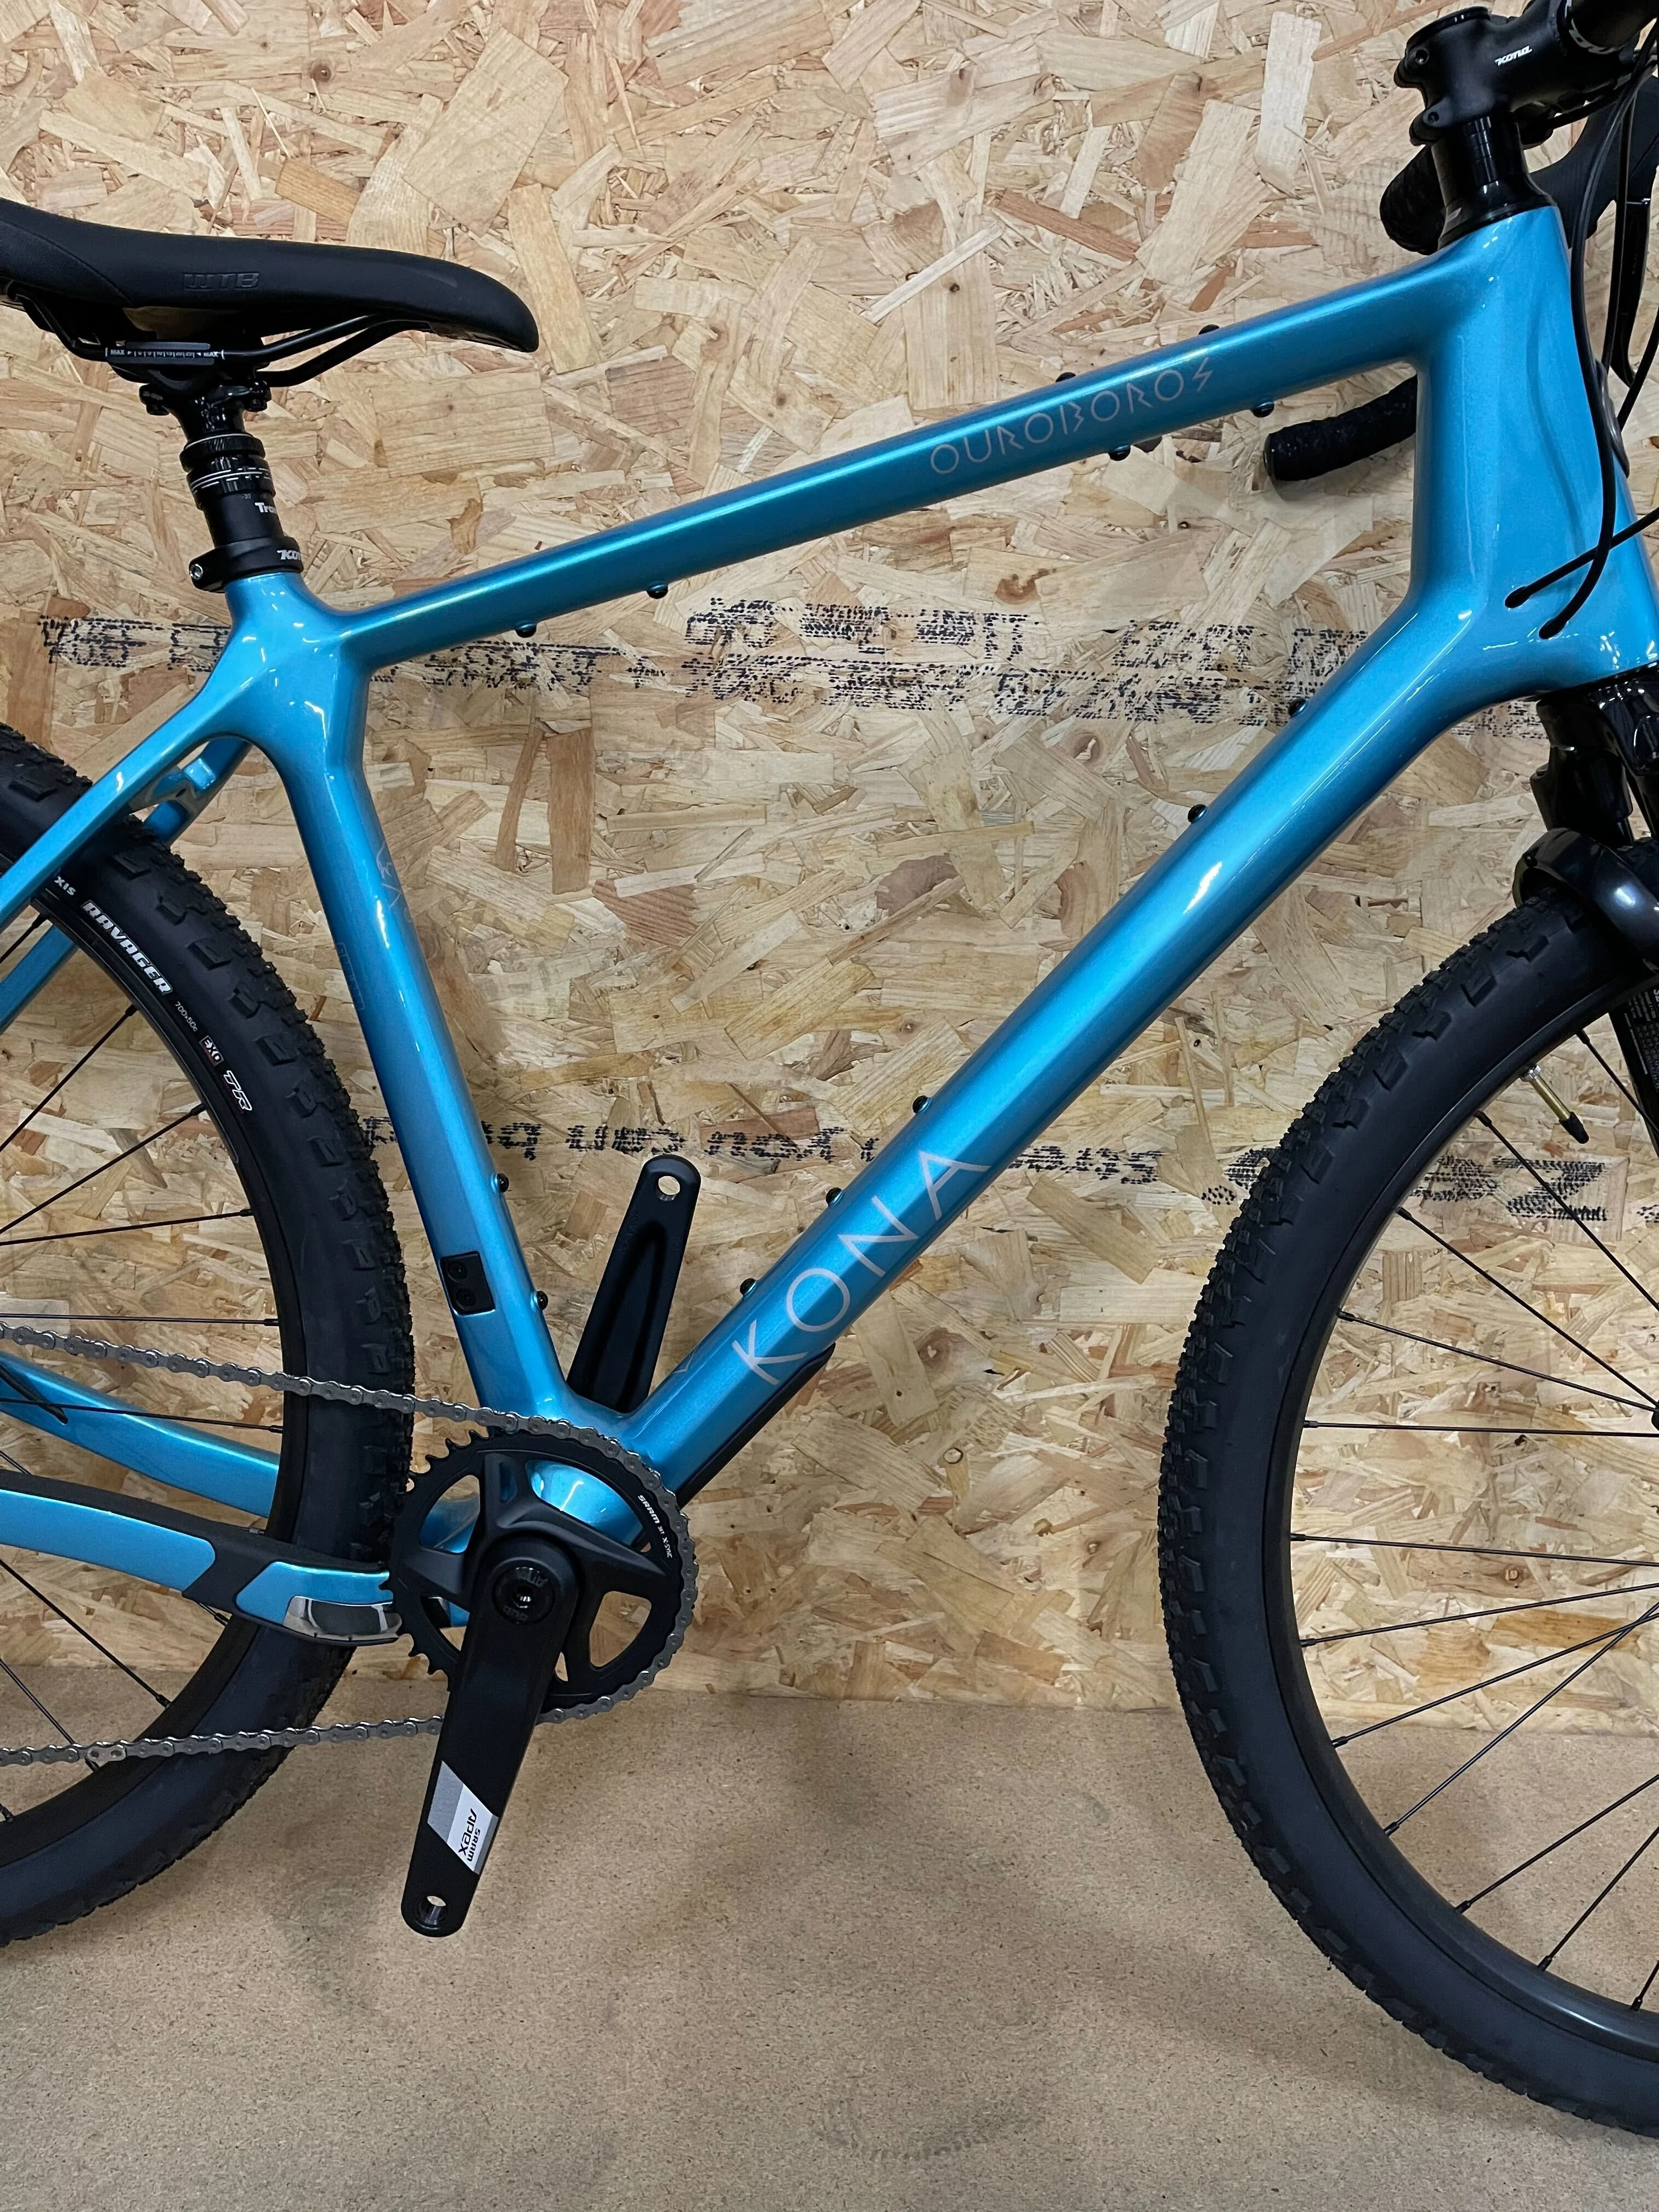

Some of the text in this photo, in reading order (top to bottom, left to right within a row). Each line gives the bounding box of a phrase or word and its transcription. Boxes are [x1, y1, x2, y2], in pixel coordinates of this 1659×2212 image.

[183, 272, 260, 290] WTB
[930, 357, 1213, 475] OUROBOROS
[81, 900, 173, 994] RAVAGER
[223, 1070, 252, 1111] TR
[732, 1150, 991, 1386] KONA
[637, 1495, 660, 1523] SRAM
[467, 1829, 481, 1861] SRAM
